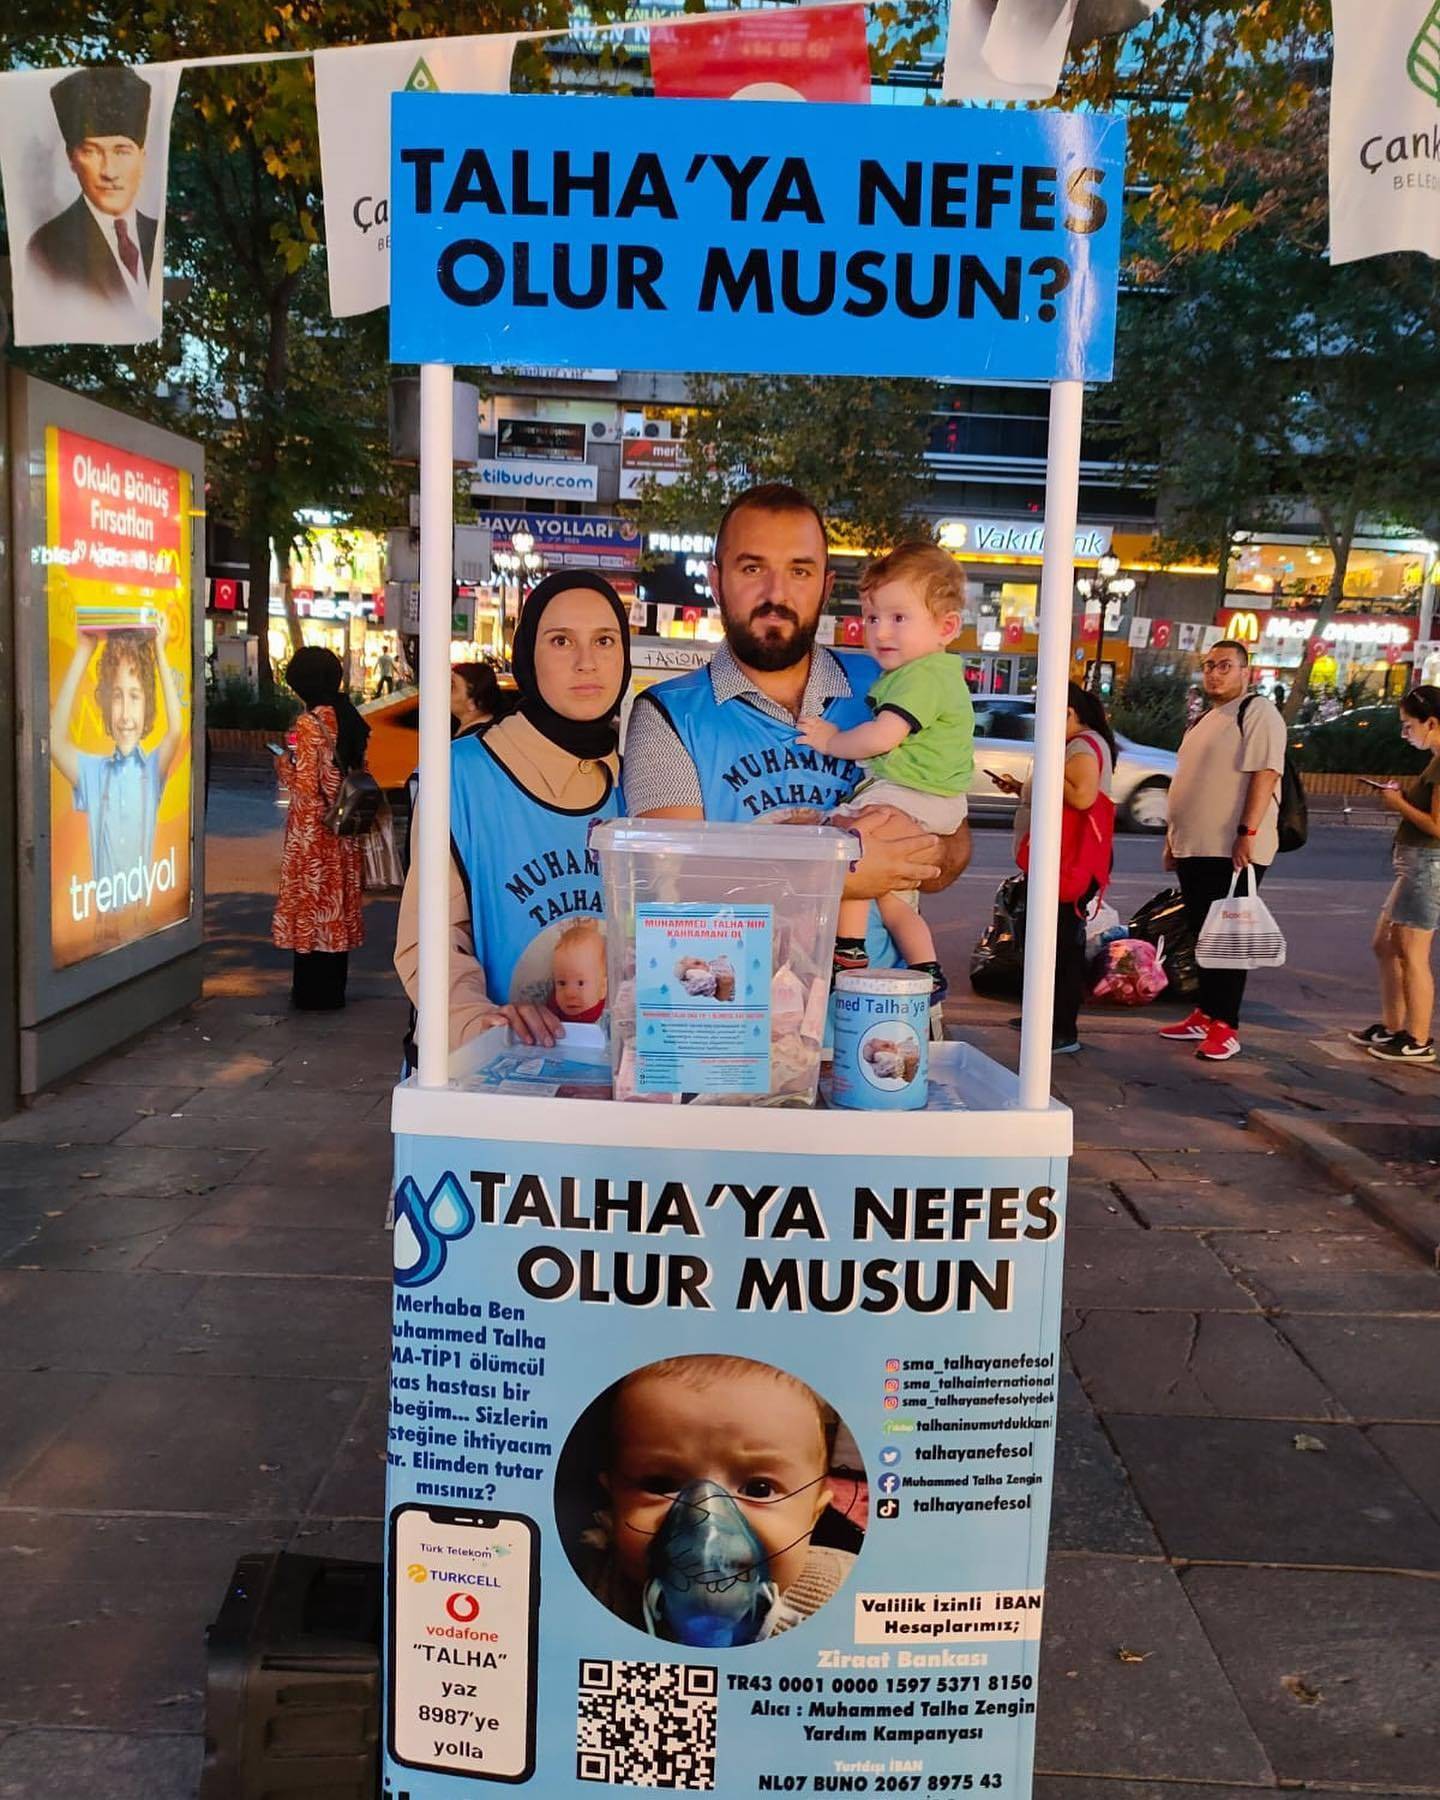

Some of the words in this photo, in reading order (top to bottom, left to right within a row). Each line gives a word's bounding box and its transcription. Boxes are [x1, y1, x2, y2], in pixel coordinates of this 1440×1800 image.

[401, 147, 825, 225] TALHA'YA
[858, 159, 1108, 236] NEFES
[352, 196, 389, 234] Ça
[437, 238, 668, 311] OLUR
[697, 244, 1071, 323] MUSUN?
[72, 453, 121, 498] Okula
[124, 471, 170, 519] Dönüş
[482, 467, 594, 489] tilbudur.com
[477, 516, 530, 535] HAVA
[535, 520, 614, 539] YOLLARI
[722, 746, 866, 793] MUHAMME
[743, 784, 850, 816] TALHA'Y
[70, 845, 177, 922] trendyol
[504, 848, 600, 905] MUHAM
[528, 889, 604, 928] TALHA
[835, 997, 861, 1012] med
[470, 1170, 828, 1240] TALHA'YA
[853, 1185, 1060, 1242] NEFES
[516, 1244, 715, 1311] OLUR
[735, 1256, 1016, 1314] MUSUN
[396, 1294, 482, 1318] Merhaba
[488, 1301, 525, 1321] Ben
[392, 1319, 487, 1345] uhammed
[493, 1328, 546, 1350] Talha
[469, 1352, 545, 1376] ölümcül
[902, 1352, 1054, 1375] sma_talhayanefesol
[426, 1373, 497, 1398] hastası
[503, 1381, 531, 1402] bir
[902, 1373, 1055, 1393] sma_talhainternational
[387, 1396, 470, 1422] beğim...
[476, 1405, 548, 1430] Sizlerin
[387, 1425, 458, 1447] steğine
[463, 1429, 552, 1456] ihtiyacım
[914, 1441, 1034, 1463] talhayanefesol
[386, 1451, 407, 1468] ar.
[413, 1450, 489, 1476] Elimden
[495, 1460, 544, 1481] tutar
[416, 1480, 497, 1501] mısınız?
[901, 1475, 969, 1488] Muhammed
[972, 1473, 1003, 1487] Talha
[1006, 1472, 1043, 1487] Zengin
[913, 1494, 1032, 1515] talhayanefesol
[419, 1543, 443, 1555] Türk
[446, 1545, 492, 1559] Telekom
[429, 1569, 502, 1588] TURKCELL
[862, 1597, 926, 1613] Valilik
[933, 1594, 982, 1612] İzinli
[995, 1592, 1042, 1610] İBAN
[425, 1624, 499, 1643] vodafone
[884, 1619, 1020, 1637] Hesaplarımız;
[816, 1649, 890, 1669] Ziraat
[897, 1648, 988, 1668] Bankası
[441, 1680, 477, 1698] yaz
[727, 1674, 772, 1691] TR43
[778, 1676, 824, 1693] 0001
[831, 1677, 878, 1693] 0000
[886, 1677, 931, 1693] 1597
[936, 1675, 981, 1692] 5371
[987, 1674, 1033, 1691] 8150
[418, 1704, 500, 1732] 8987'ye
[751, 1699, 790, 1717] Alıcı
[808, 1700, 914, 1718] Muhammed
[920, 1700, 969, 1717] Talha
[975, 1697, 1036, 1718] Zengin
[803, 1725, 867, 1742] Yardım
[873, 1726, 984, 1745] Kampanyası
[433, 1740, 484, 1759] yolla
[758, 1775, 806, 1791] NL07
[813, 1775, 868, 1792] BUNO
[874, 1775, 921, 1792] 2067
[927, 1774, 973, 1791] 8975
[980, 1773, 1003, 1790] 43
